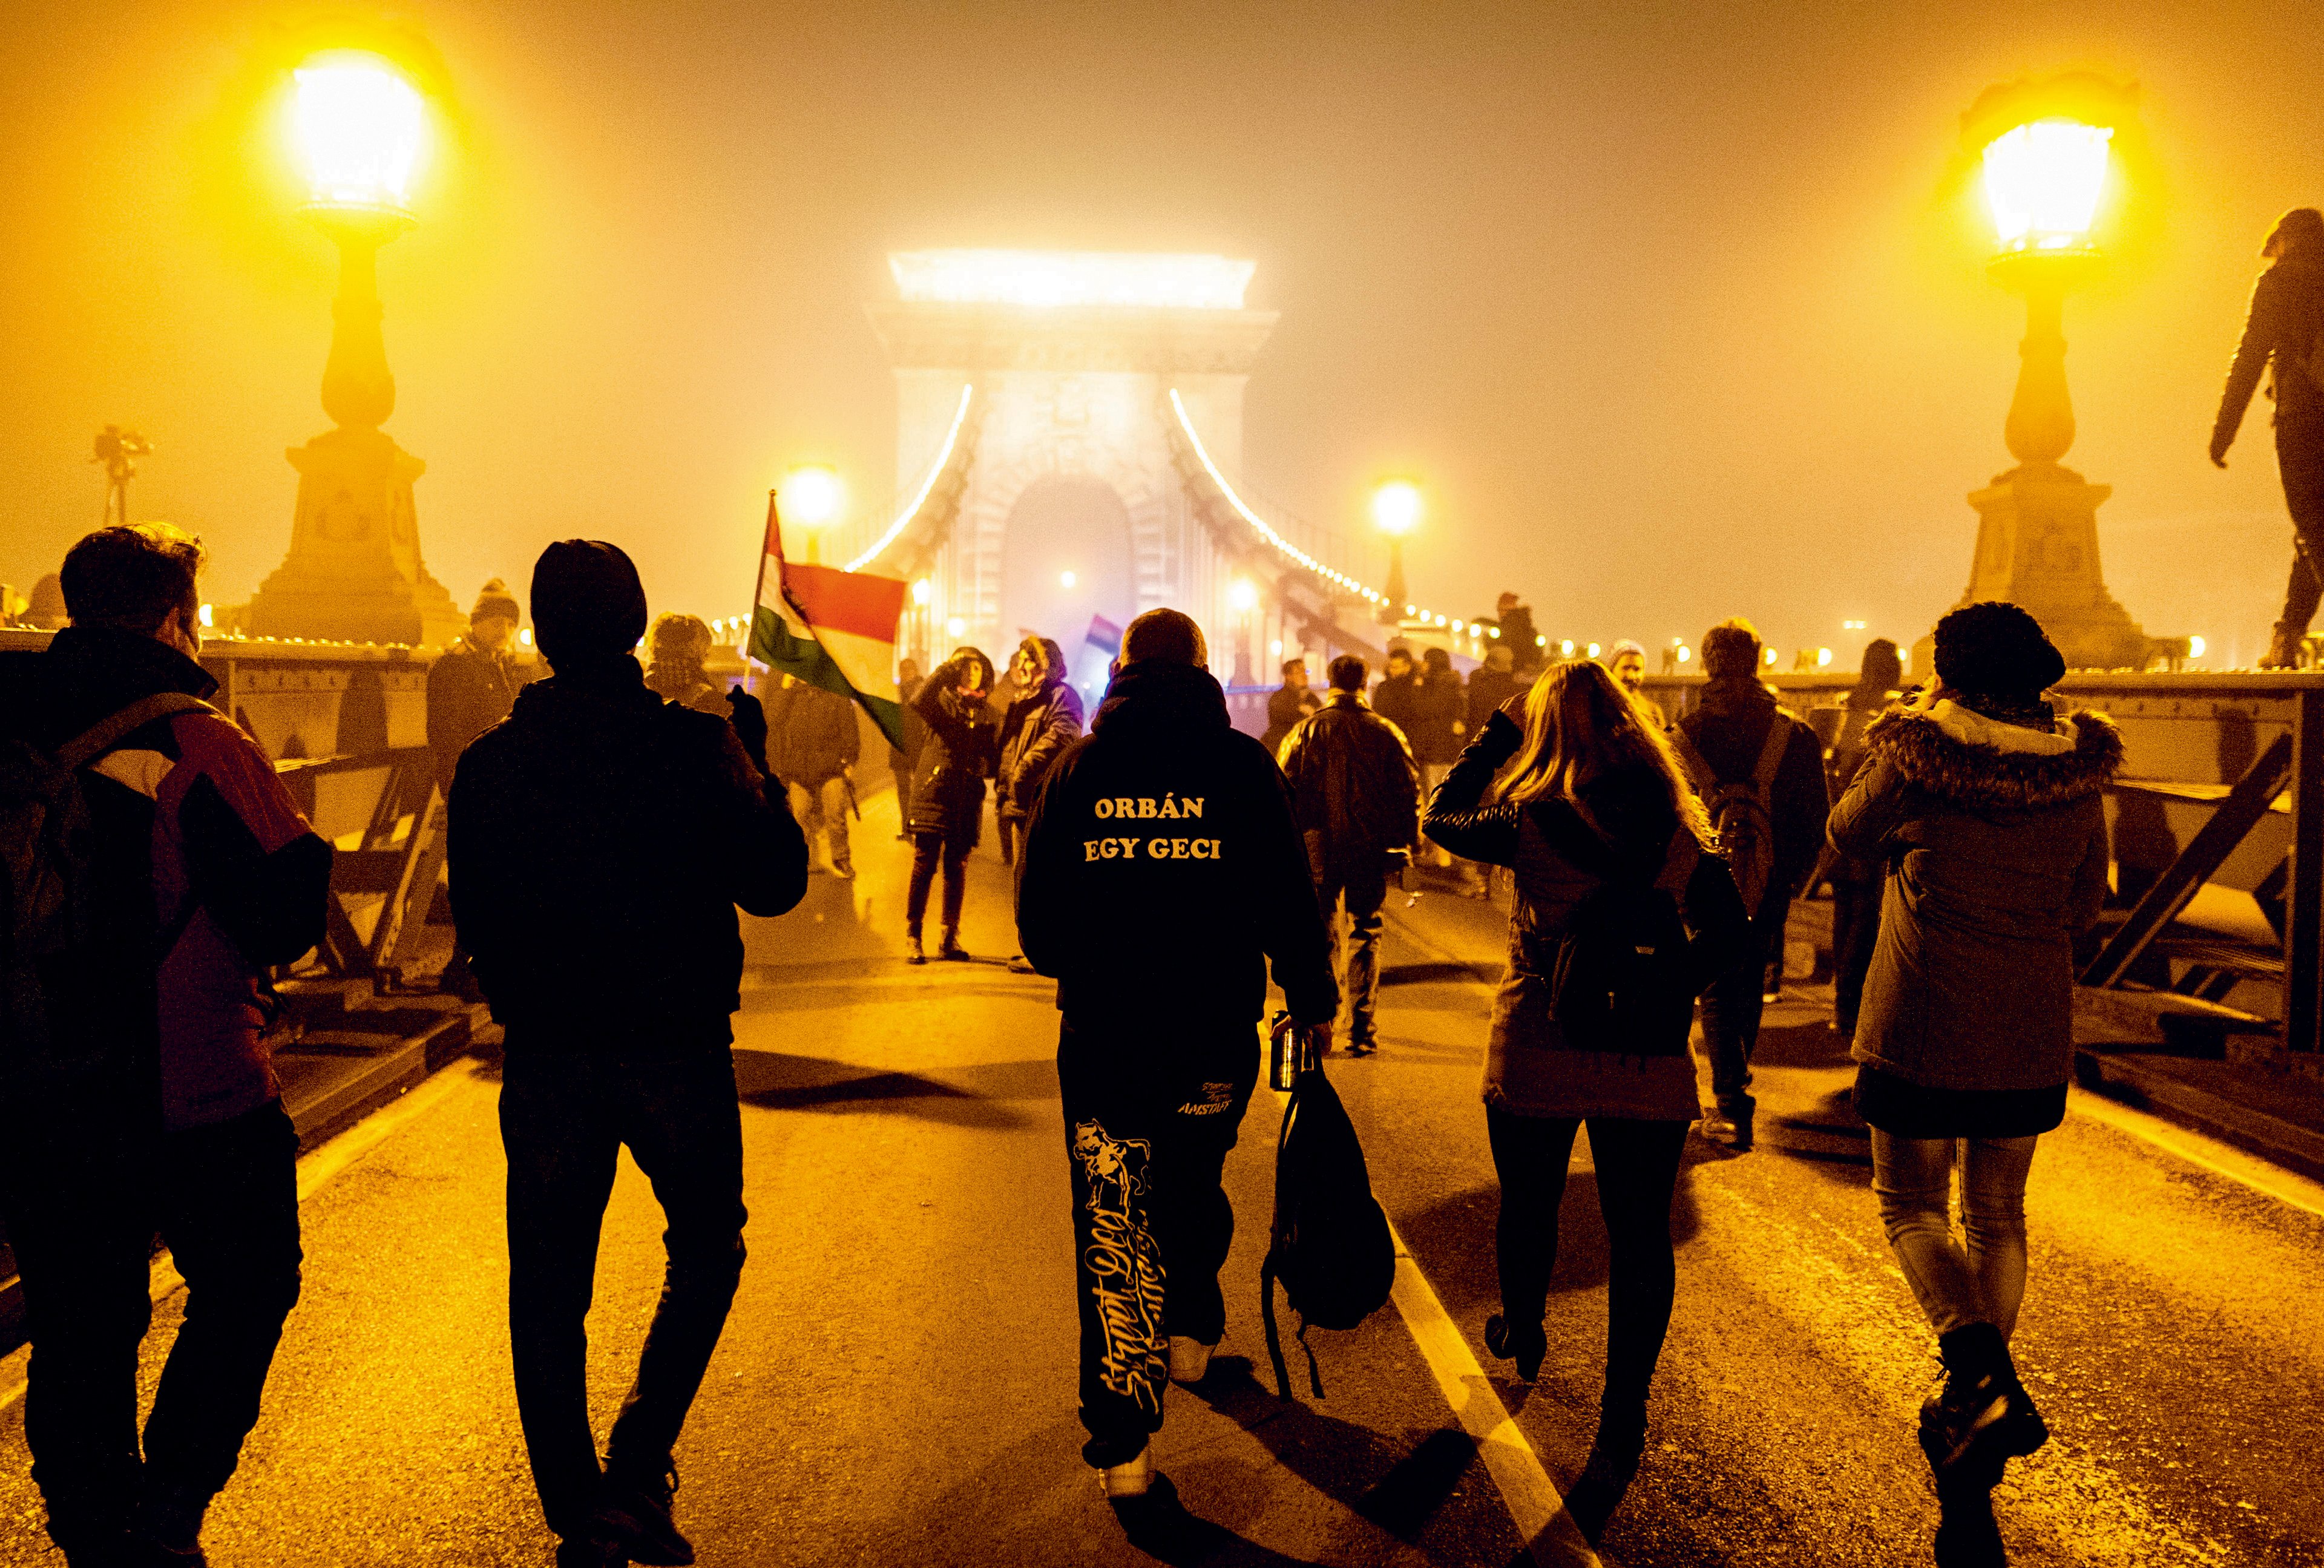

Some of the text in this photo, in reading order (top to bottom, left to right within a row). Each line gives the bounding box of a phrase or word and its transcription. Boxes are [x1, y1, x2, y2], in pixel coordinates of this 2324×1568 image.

[1094, 791, 1205, 819] ORBÁN
[1083, 838, 1221, 862] EGY GECI
